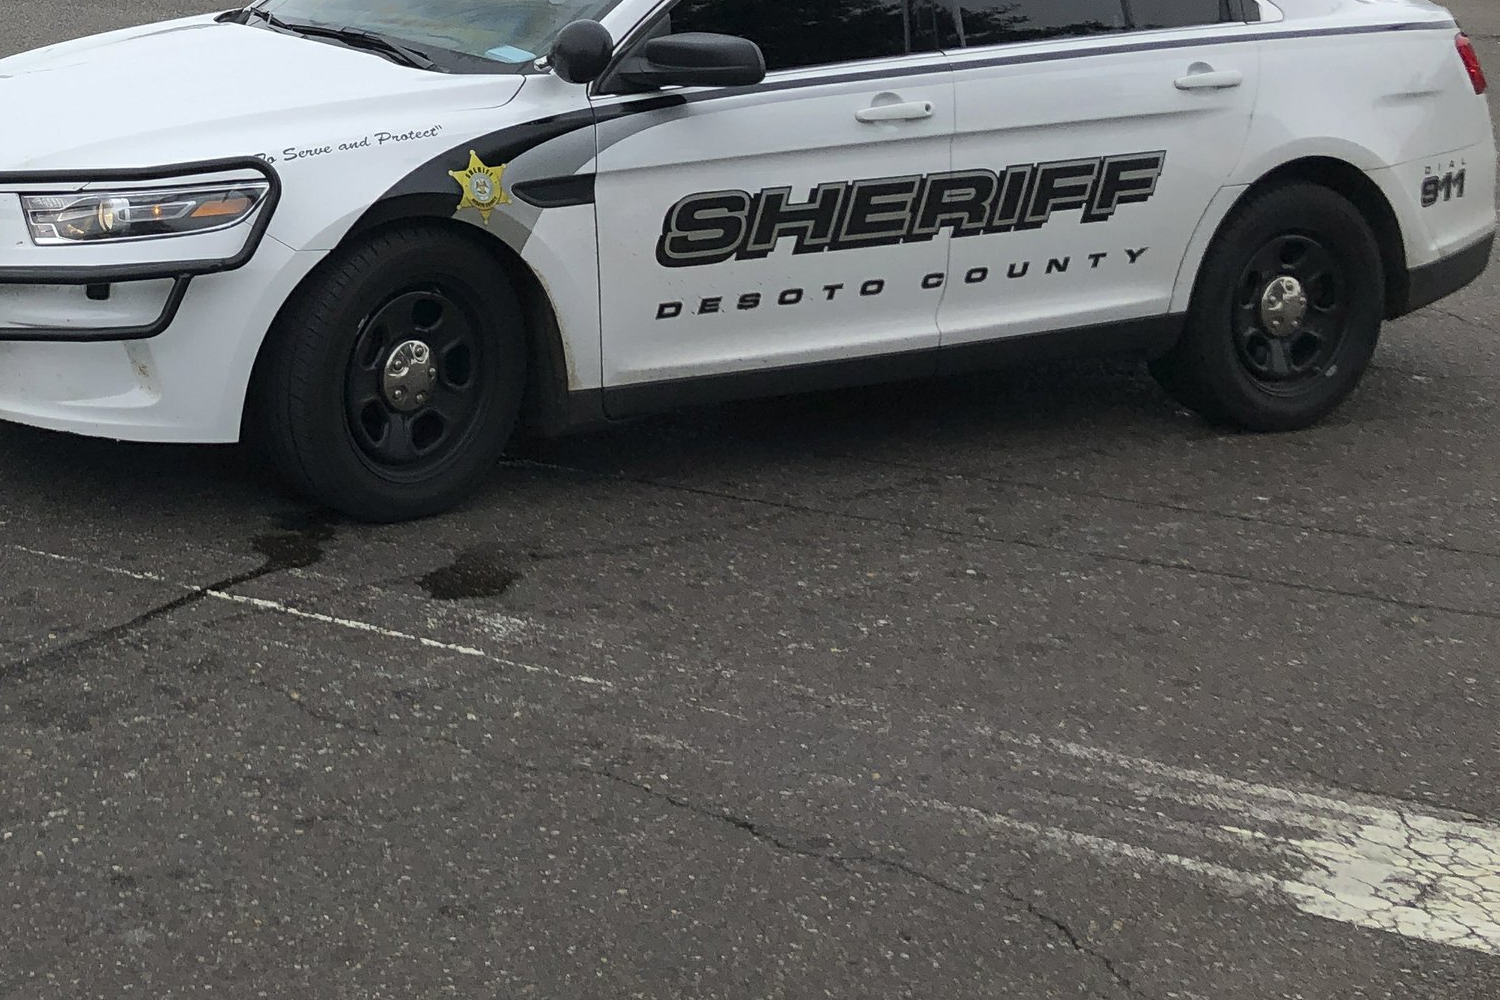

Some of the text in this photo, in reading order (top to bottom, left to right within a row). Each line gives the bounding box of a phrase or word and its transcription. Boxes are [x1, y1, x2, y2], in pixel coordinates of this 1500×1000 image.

[282, 145, 333, 161] Serve
[337, 136, 371, 152] and
[654, 149, 1167, 269] SHERIFF
[1420, 167, 1466, 209] 911
[655, 246, 1150, 321] DESOTO COUNTY
